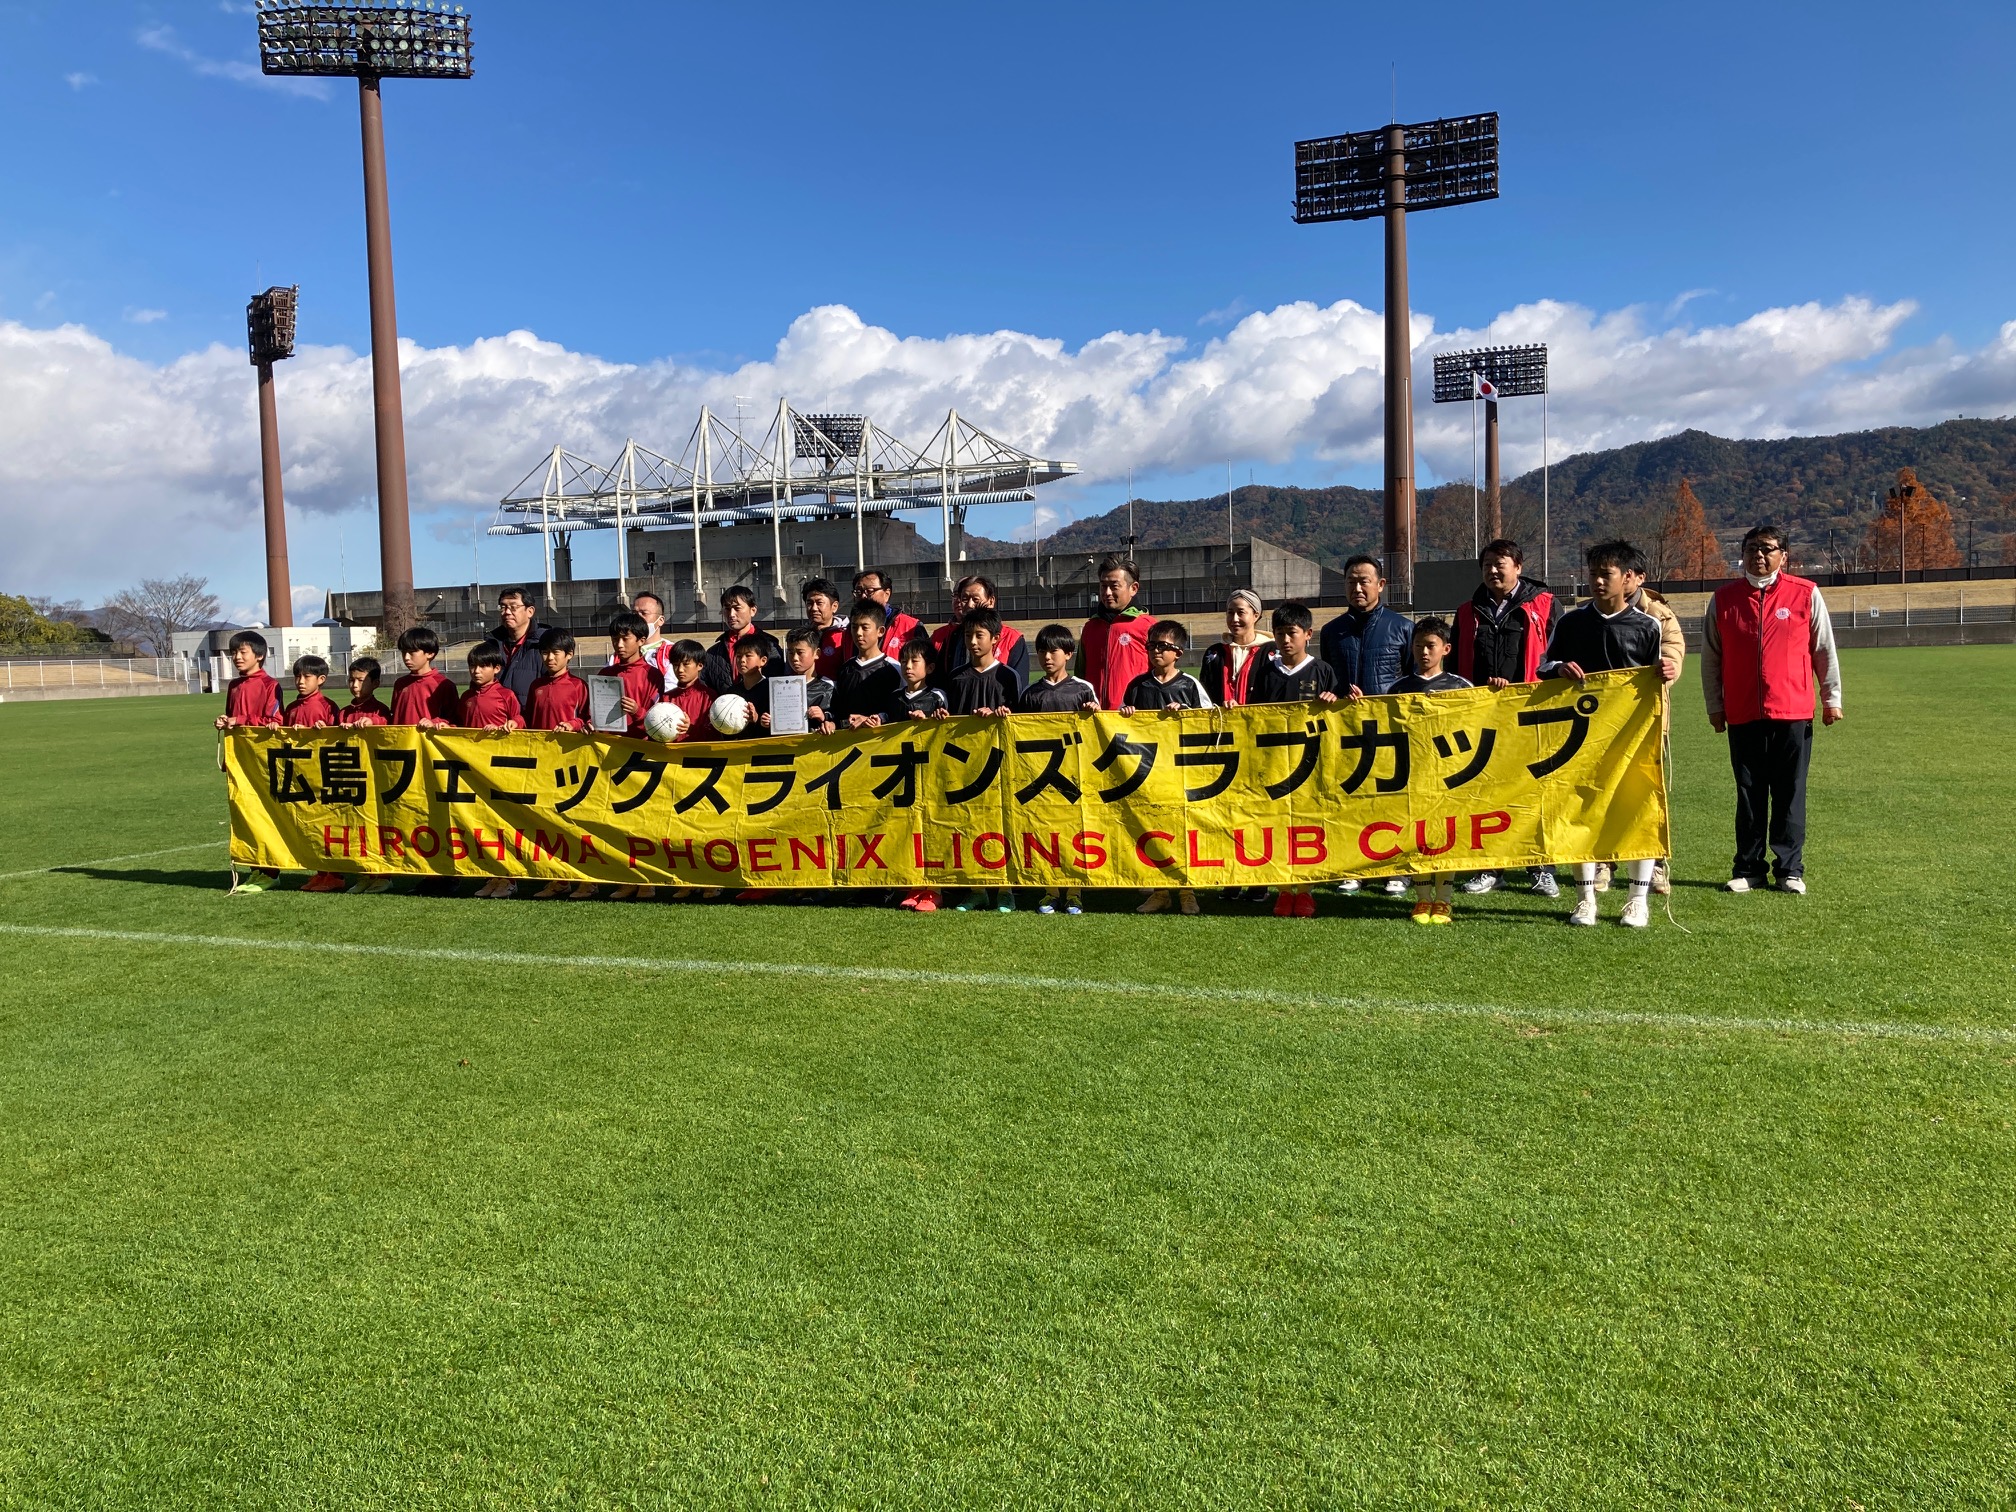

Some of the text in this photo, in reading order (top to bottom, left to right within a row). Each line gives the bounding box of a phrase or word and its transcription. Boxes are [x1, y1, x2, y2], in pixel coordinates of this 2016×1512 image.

[266, 695, 1600, 816] 広島フェニックスライオンズクラブカップ
[324, 811, 1512, 872] HIROSHIMA PHOENIX LIONS CLUB CUP
